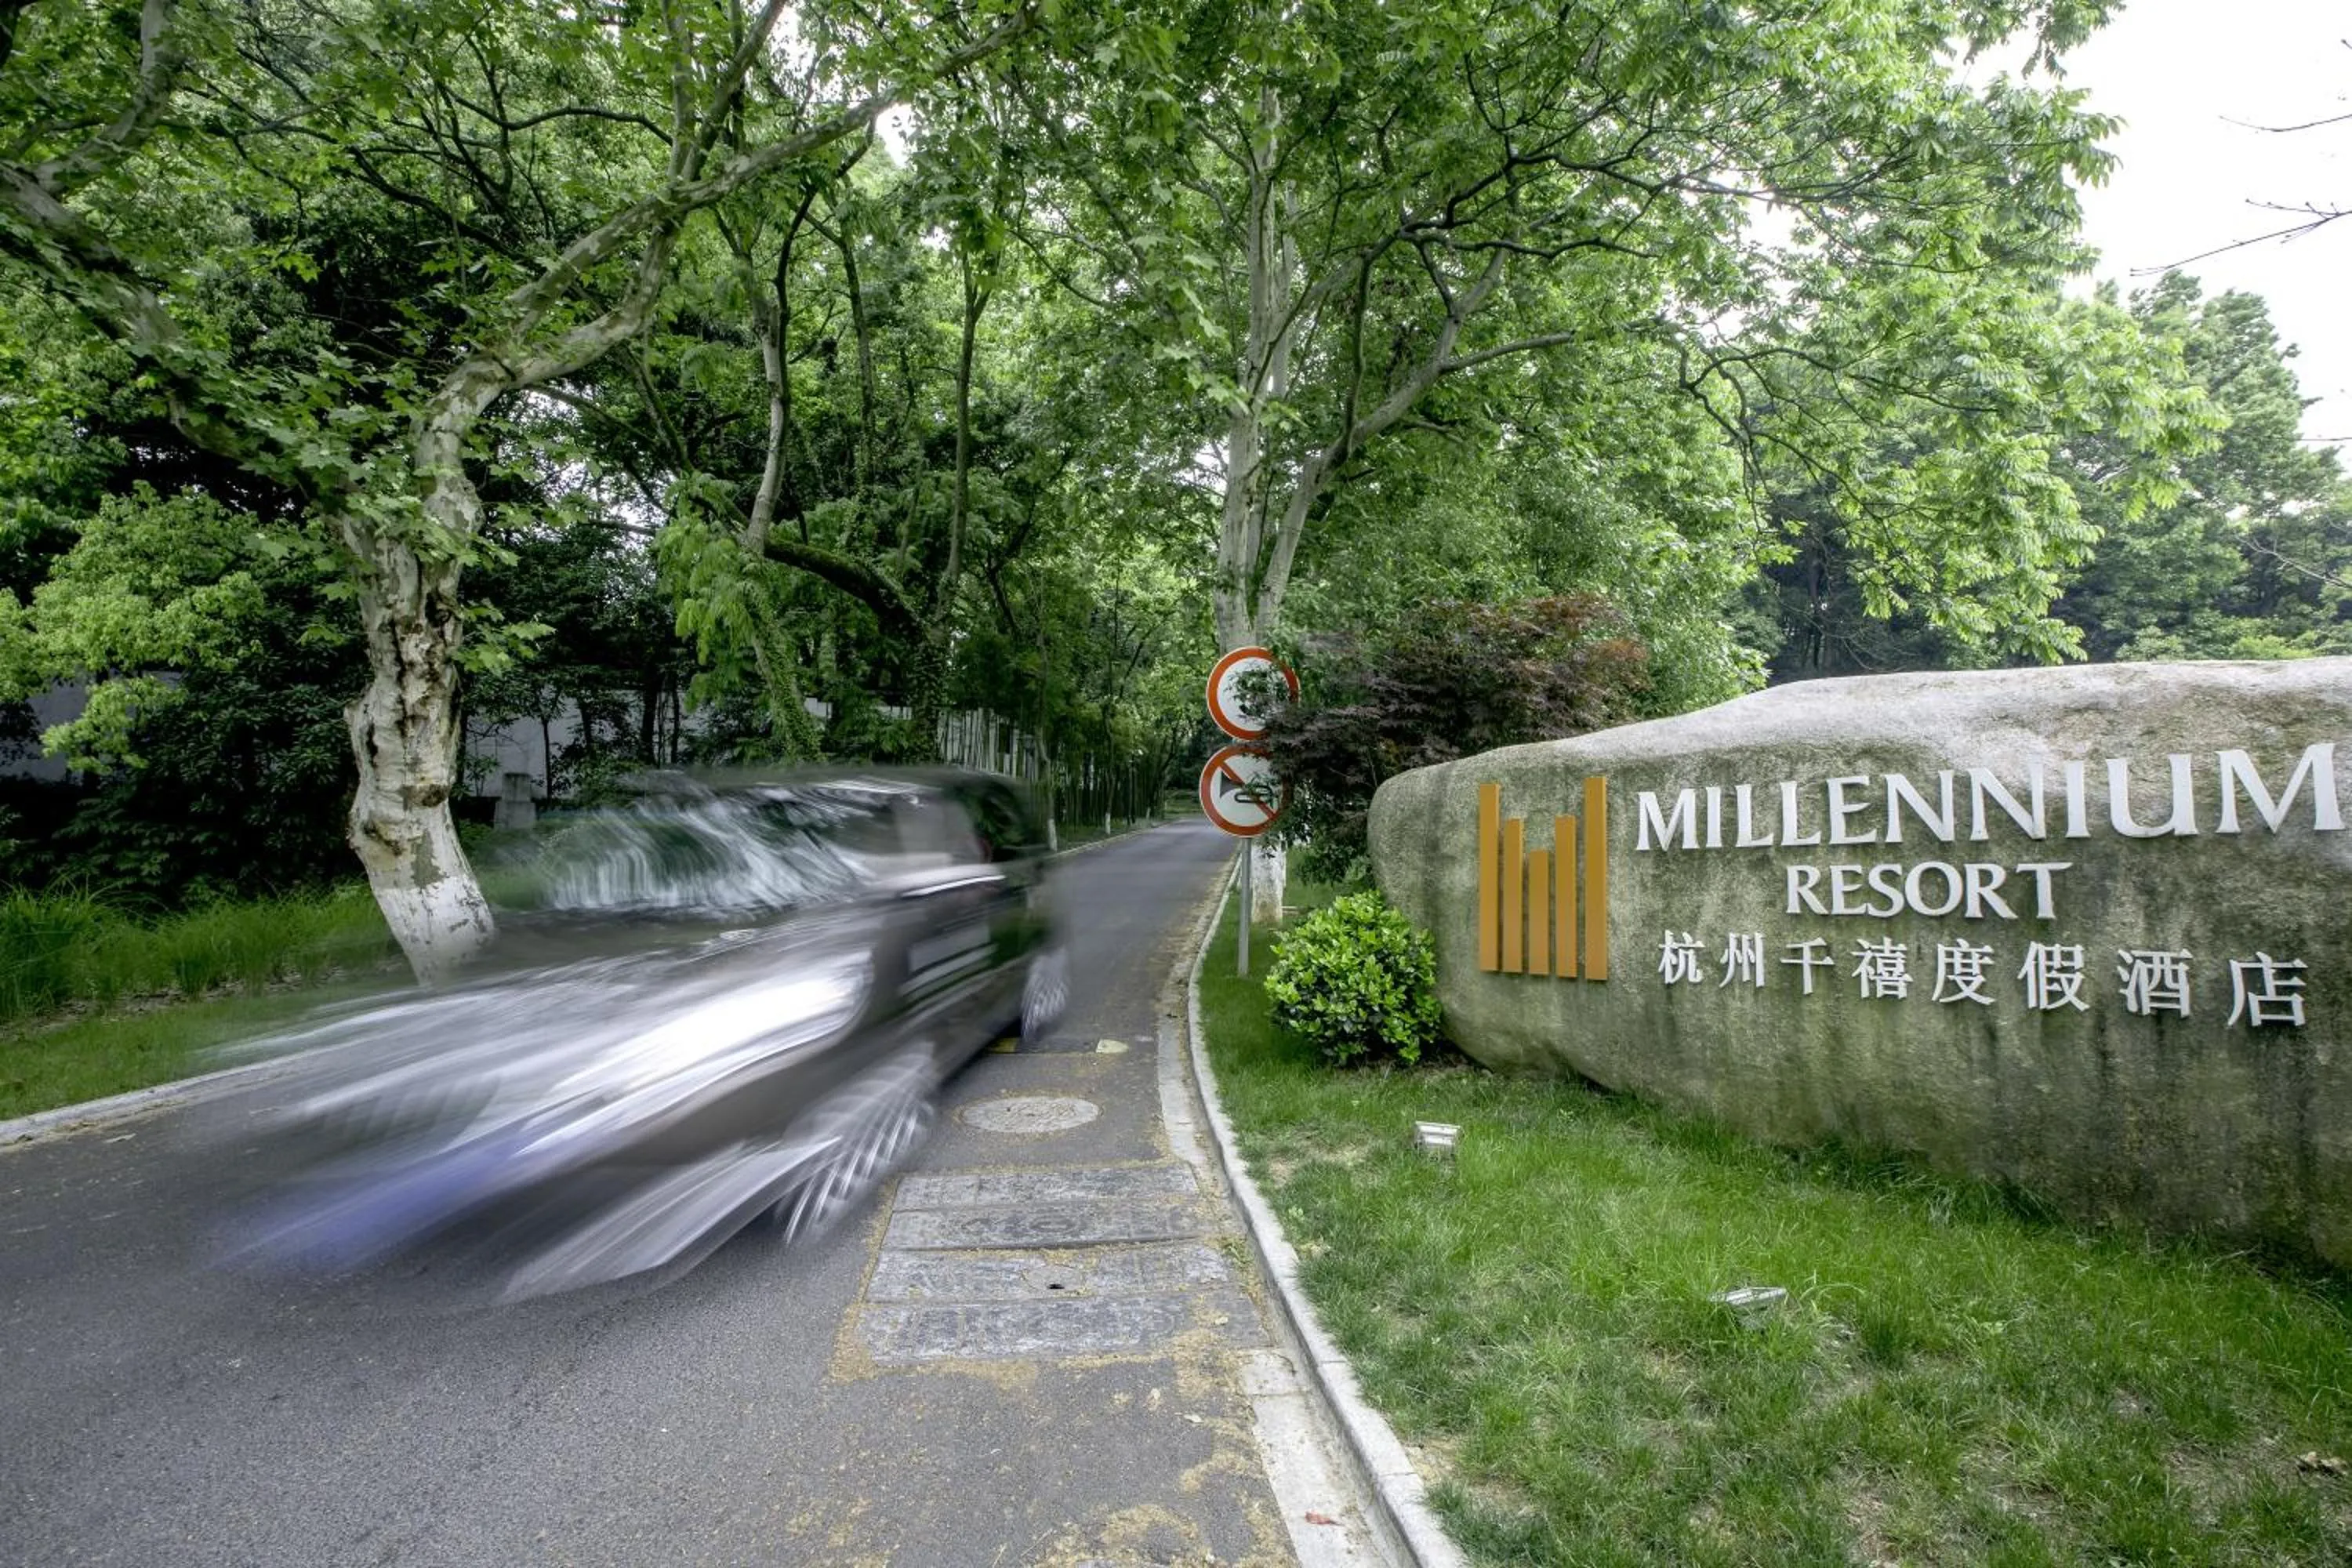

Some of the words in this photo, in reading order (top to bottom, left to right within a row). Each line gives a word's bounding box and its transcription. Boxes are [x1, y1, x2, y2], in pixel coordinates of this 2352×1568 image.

[1636, 742, 2344, 851] MILLENNIUM
[1786, 862, 2074, 920] RESORT
[1657, 931, 2308, 1027] 杭州千禧度假酒店
